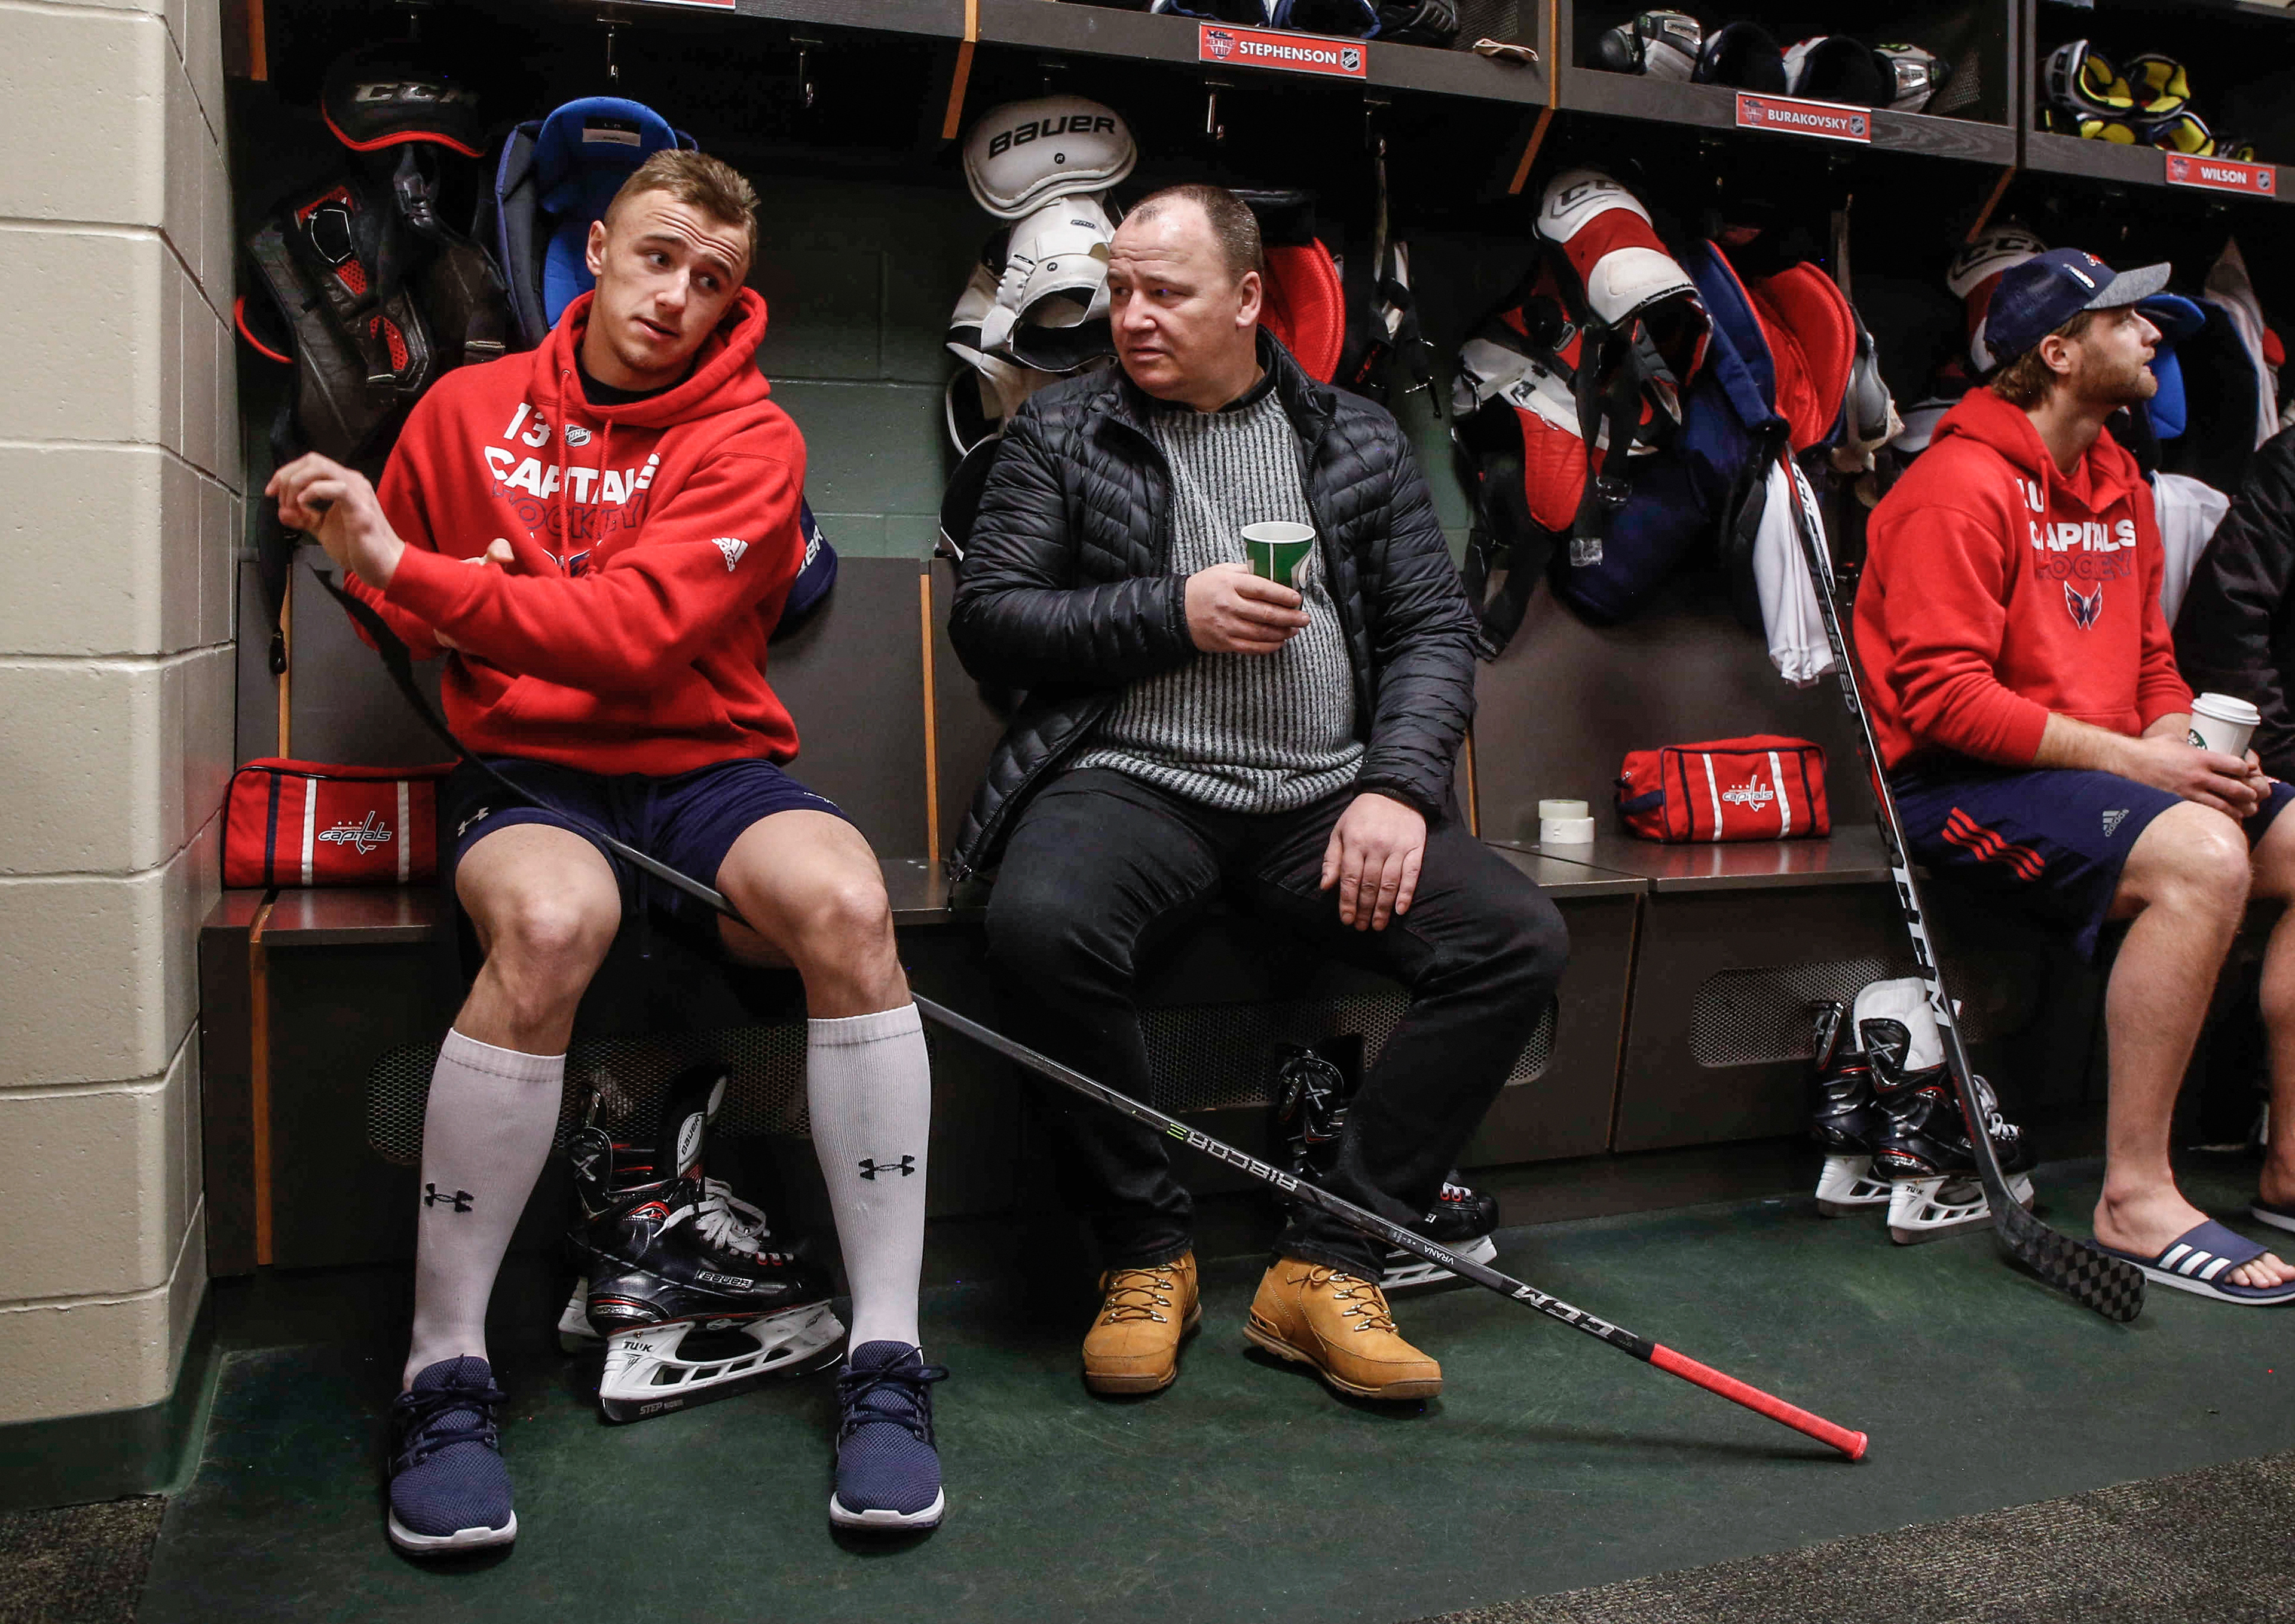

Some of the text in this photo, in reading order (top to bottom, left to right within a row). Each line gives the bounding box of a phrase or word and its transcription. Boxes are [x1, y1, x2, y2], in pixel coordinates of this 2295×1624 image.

[1240, 41, 1336, 65] STEPHENSON
[1767, 109, 1848, 130] BURAKOVSKY
[989, 116, 1115, 160] BAUER
[2201, 167, 2248, 184] WILSON
[1558, 180, 1621, 206] CC
[503, 402, 551, 448] 13
[568, 429, 589, 440] NHL
[2039, 549, 2132, 581] OCEY
[319, 811, 392, 854] capitals
[2105, 809, 2129, 836] adidas
[1892, 864, 1952, 1027] CCM
[682, 1117, 699, 1155] BAUER
[1186, 1130, 1298, 1192] RIBCOR
[1425, 1245, 1454, 1265] VRANA
[702, 1273, 749, 1286] BAUER
[1511, 1285, 1615, 1338] CCM
[639, 1402, 663, 1415] STEP
